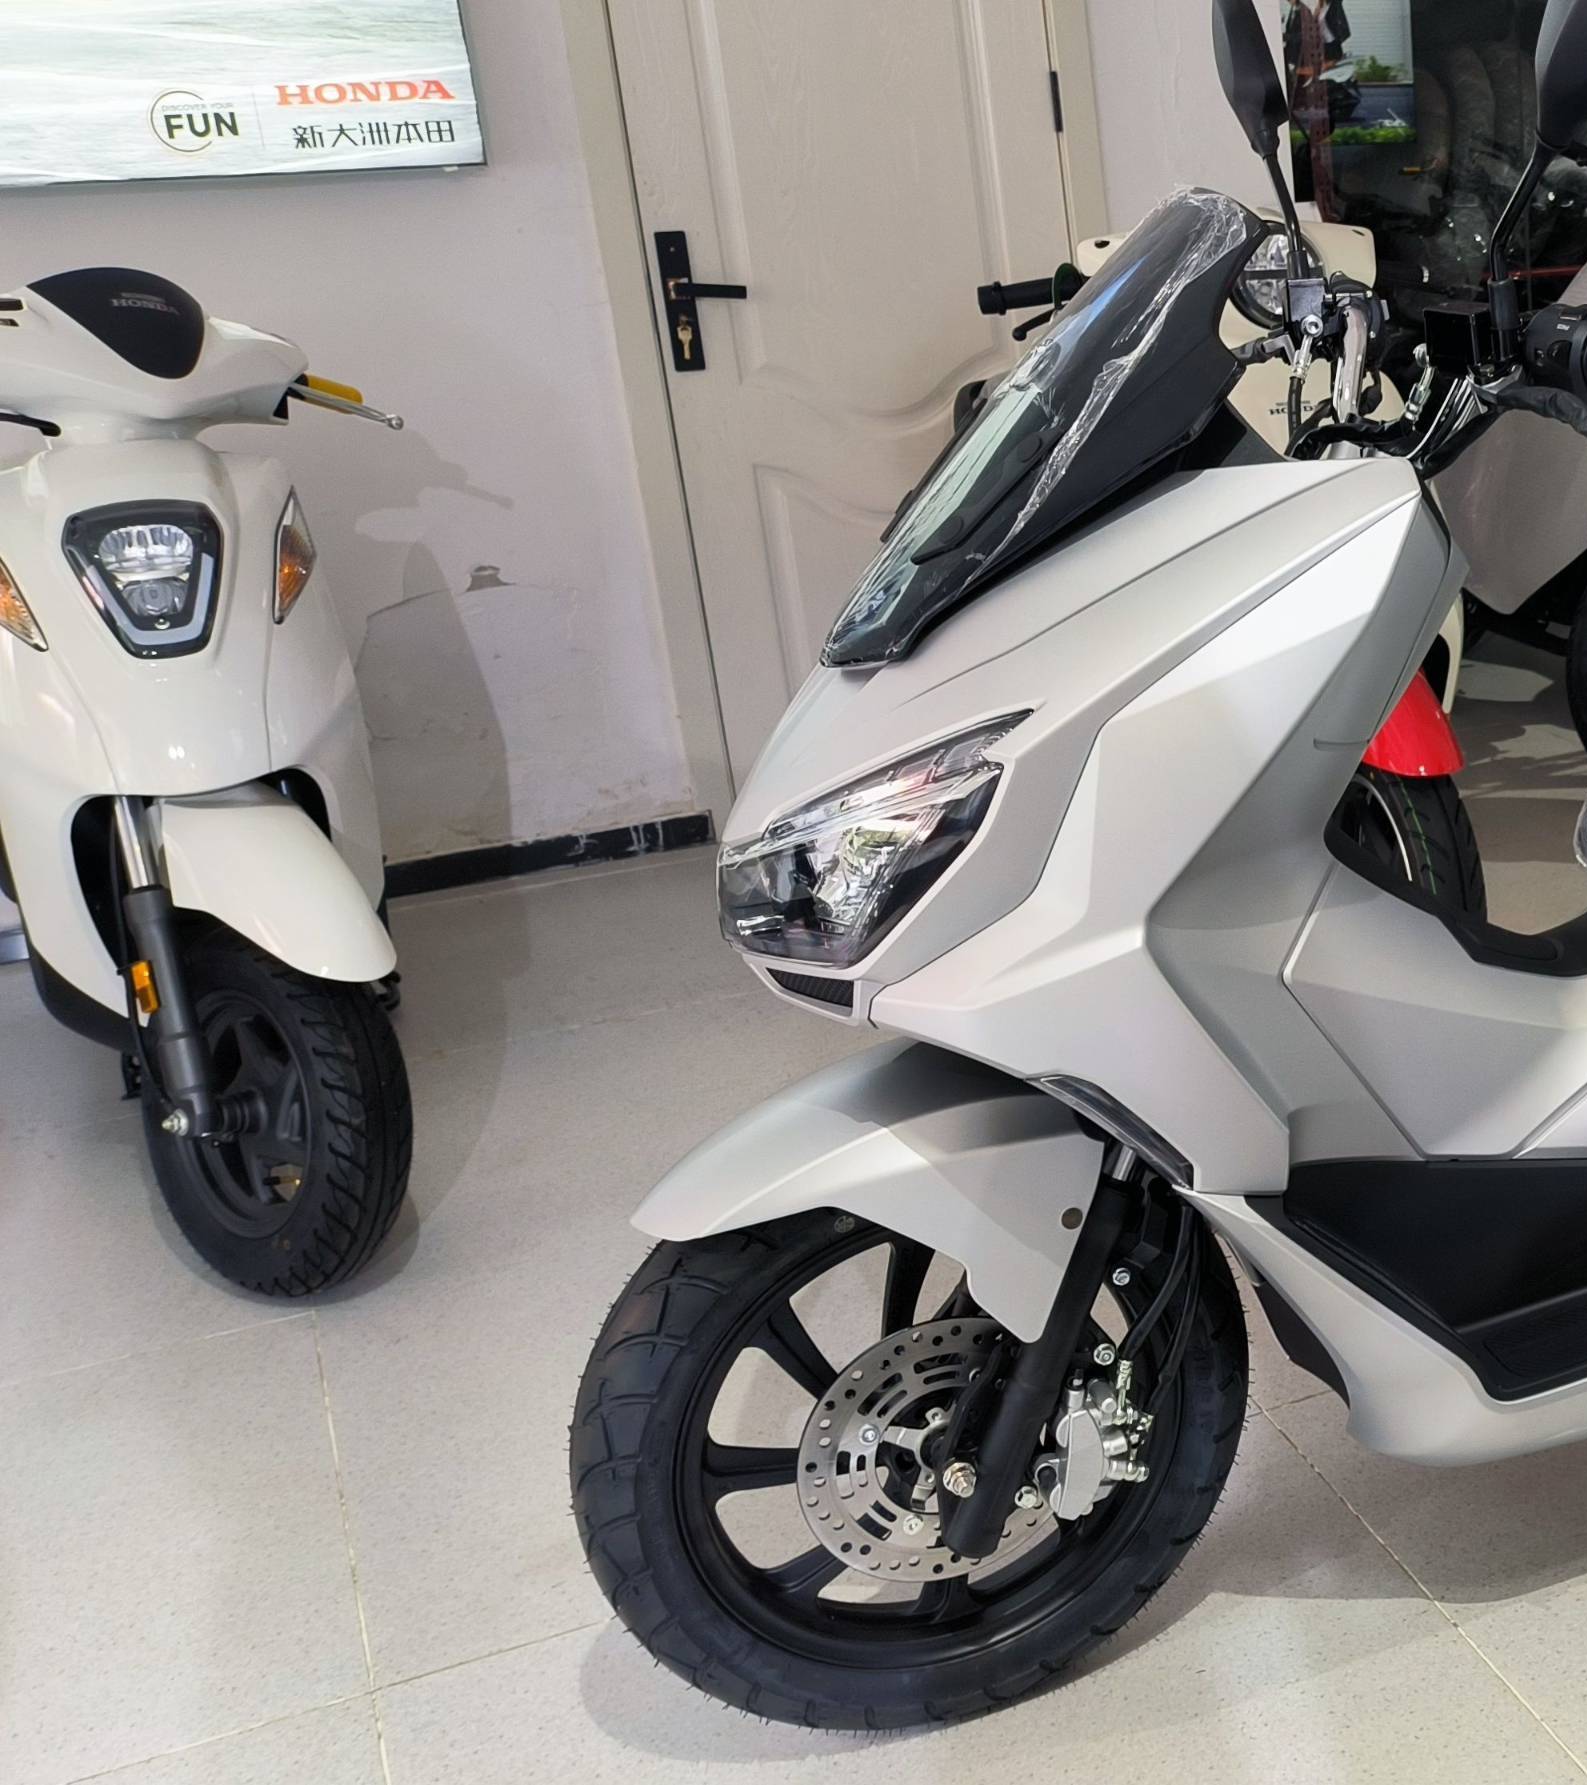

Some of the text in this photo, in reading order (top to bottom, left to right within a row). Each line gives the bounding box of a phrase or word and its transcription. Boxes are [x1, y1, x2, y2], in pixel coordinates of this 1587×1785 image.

[274, 80, 456, 106] HONDA
[163, 111, 240, 140] FUN
[292, 119, 456, 149] 新大洲本田
[1268, 404, 1317, 416] HOD
